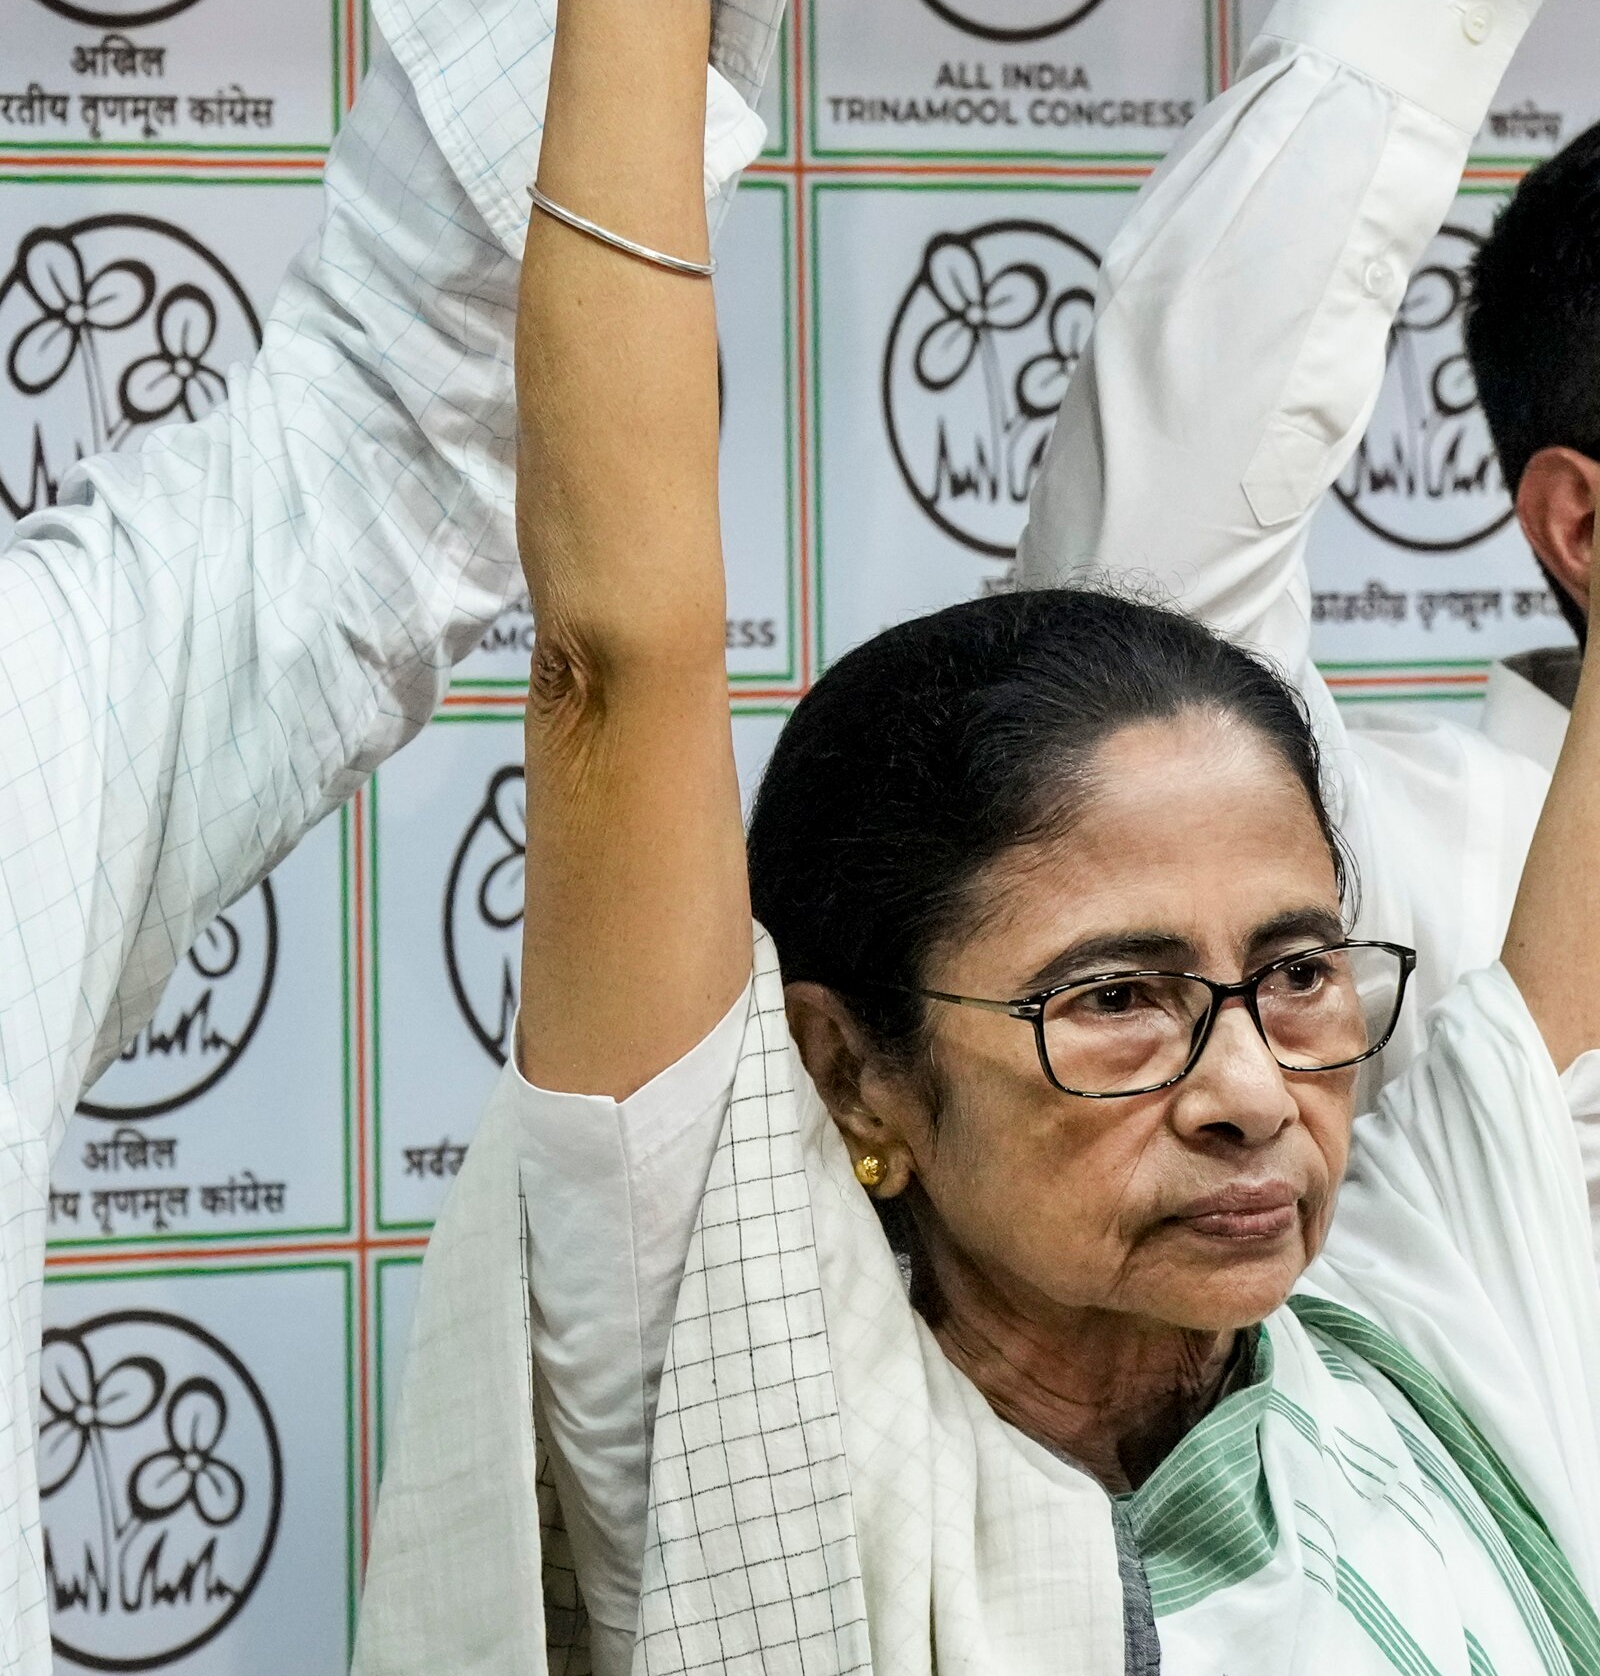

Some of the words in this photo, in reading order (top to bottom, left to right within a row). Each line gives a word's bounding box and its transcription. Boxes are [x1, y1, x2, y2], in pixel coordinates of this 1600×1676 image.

[71, 35, 165, 76] अखिल
[935, 62, 993, 91] ALL
[1001, 63, 1091, 92] INDIA
[78, 95, 178, 139] तृणमूल
[186, 83, 274, 127] कांग्रेस
[827, 96, 1018, 126] TRINAMOOL
[1028, 98, 1196, 130] CONGRESS
[82, 1128, 177, 1171] अखिल
[91, 1186, 190, 1236] तृणमूल
[198, 1167, 287, 1214] कांग्रेस
